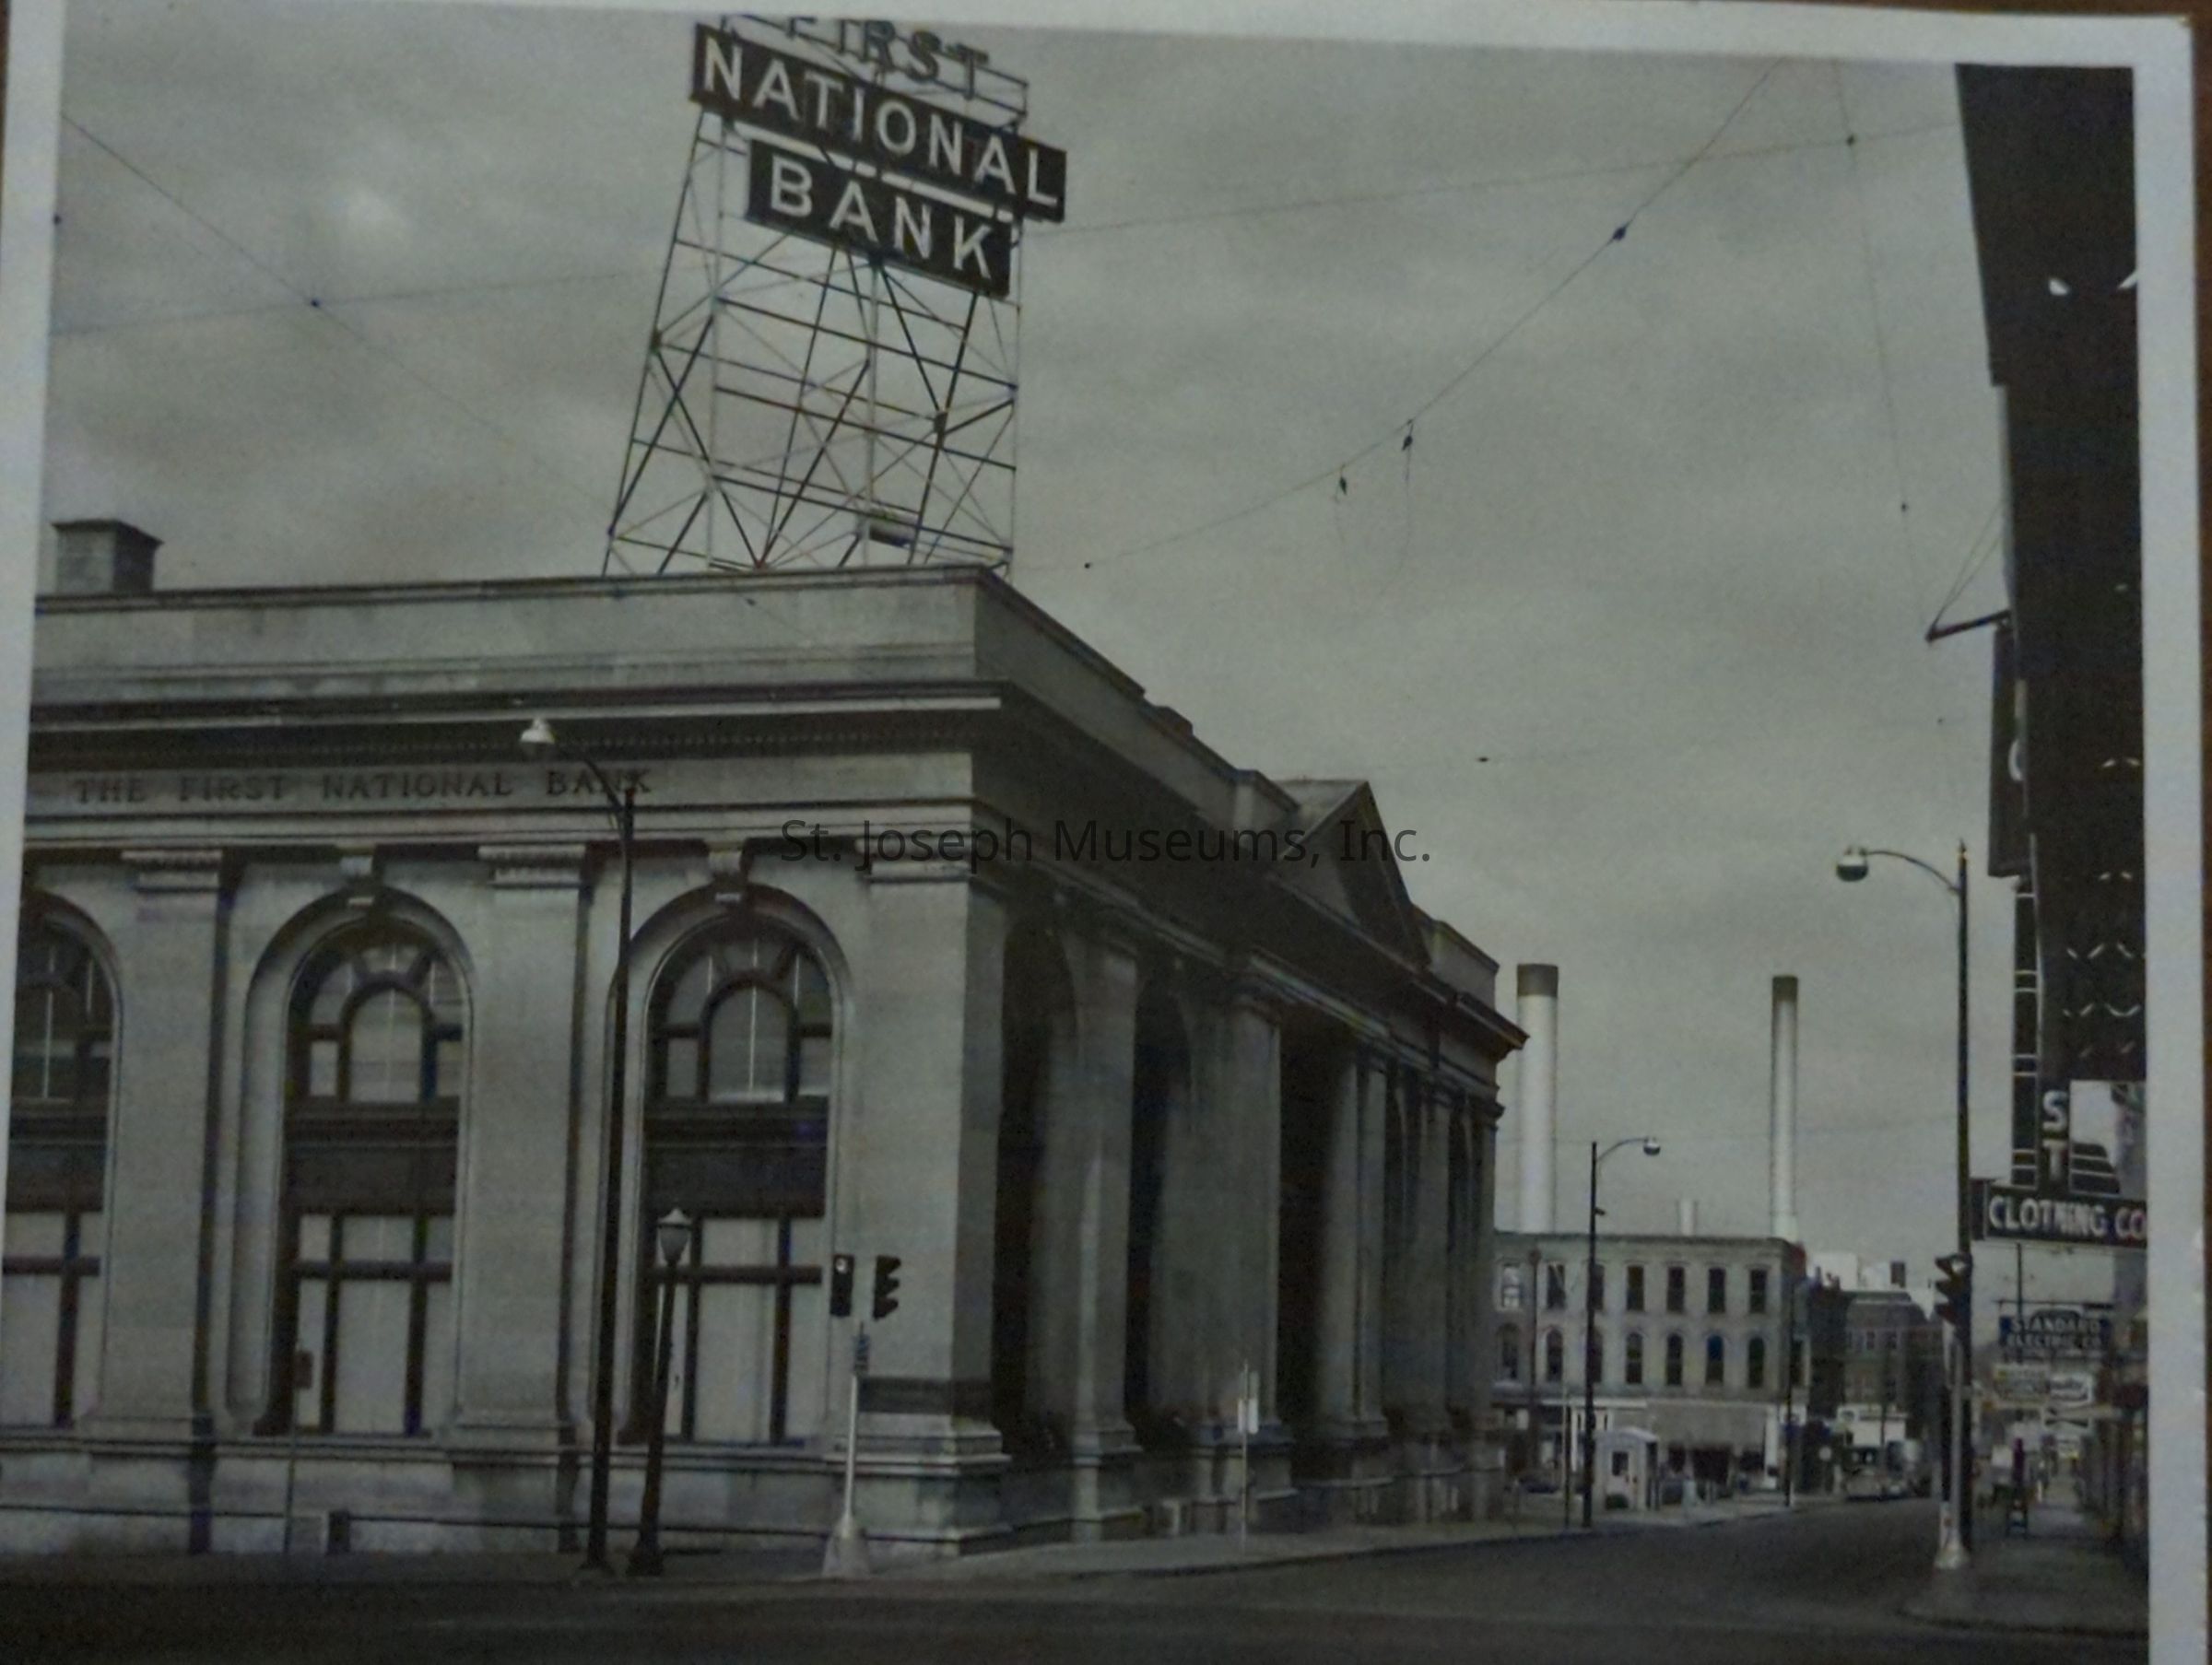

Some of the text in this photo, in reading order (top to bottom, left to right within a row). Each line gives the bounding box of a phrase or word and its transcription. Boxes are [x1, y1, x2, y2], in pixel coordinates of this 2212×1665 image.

[703, 36, 1057, 207] NATIONAL
[771, 154, 993, 280] BANK
[72, 778, 147, 804] THE
[179, 774, 288, 802] FIRST
[320, 768, 512, 800] NATIONAL
[1988, 1194, 2107, 1237] CLOTHING
